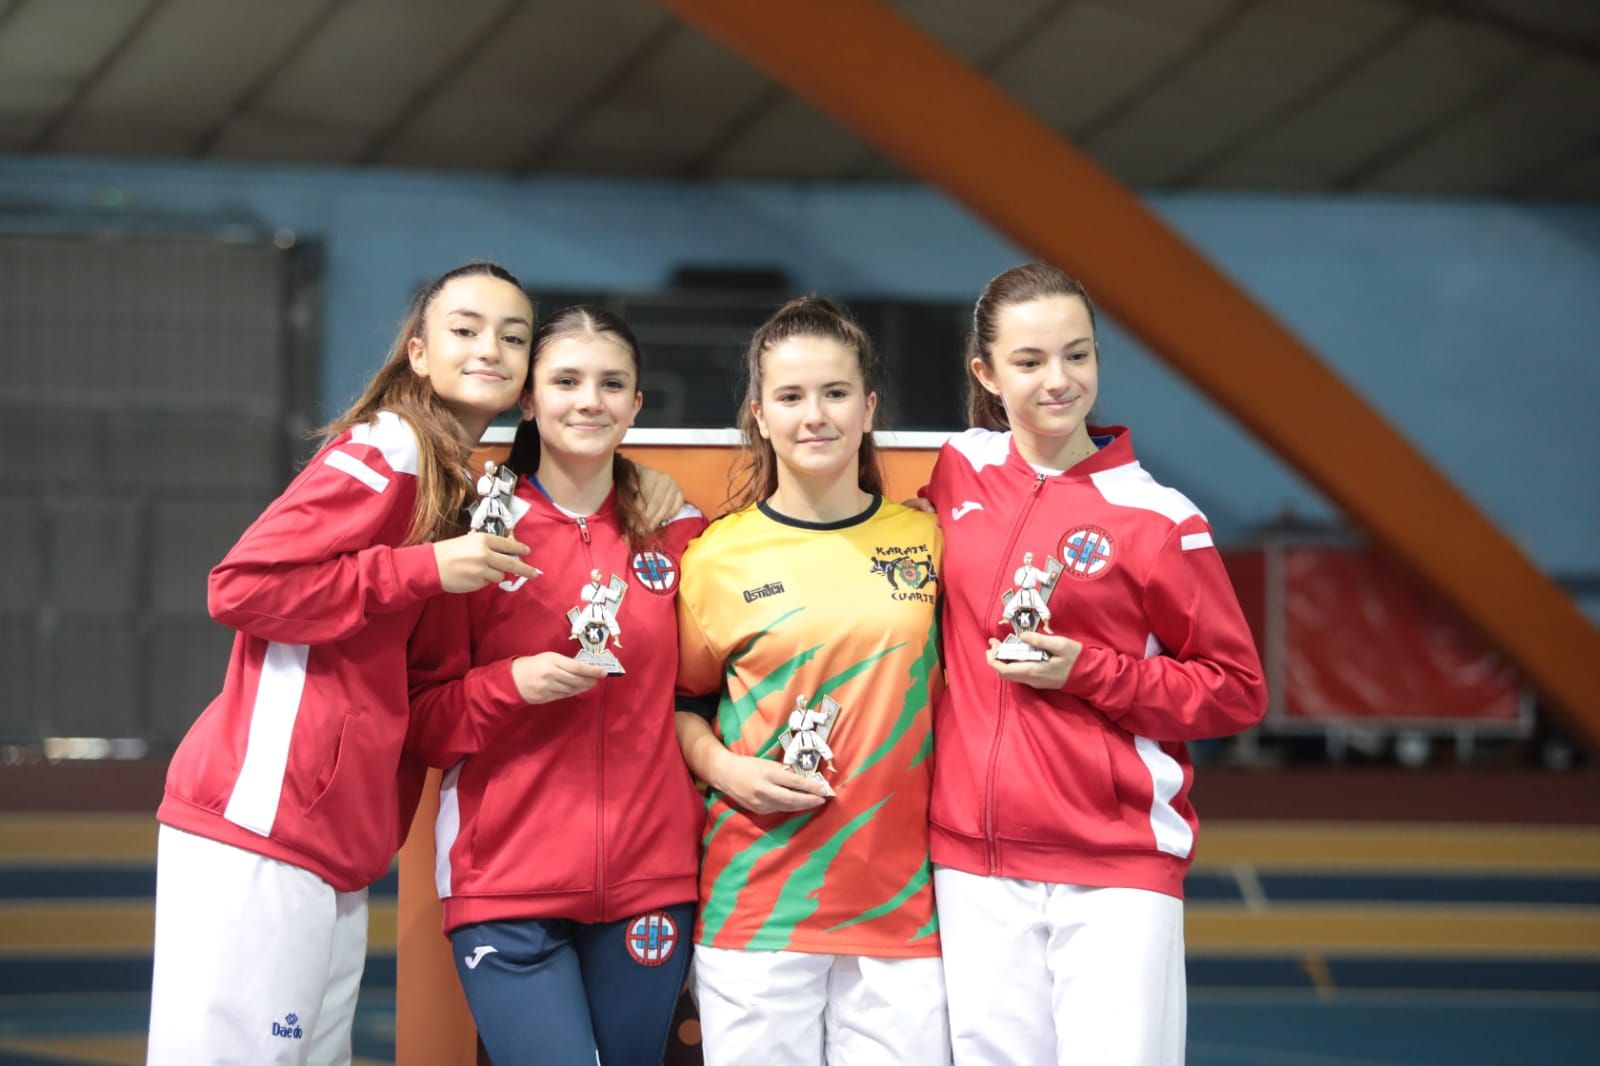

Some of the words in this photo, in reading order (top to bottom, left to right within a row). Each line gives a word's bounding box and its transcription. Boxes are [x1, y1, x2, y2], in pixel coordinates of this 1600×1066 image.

[876, 544, 928, 555] KARATE
[891, 592, 934, 604] CUARTE
[272, 1022, 303, 1039] Daedo
